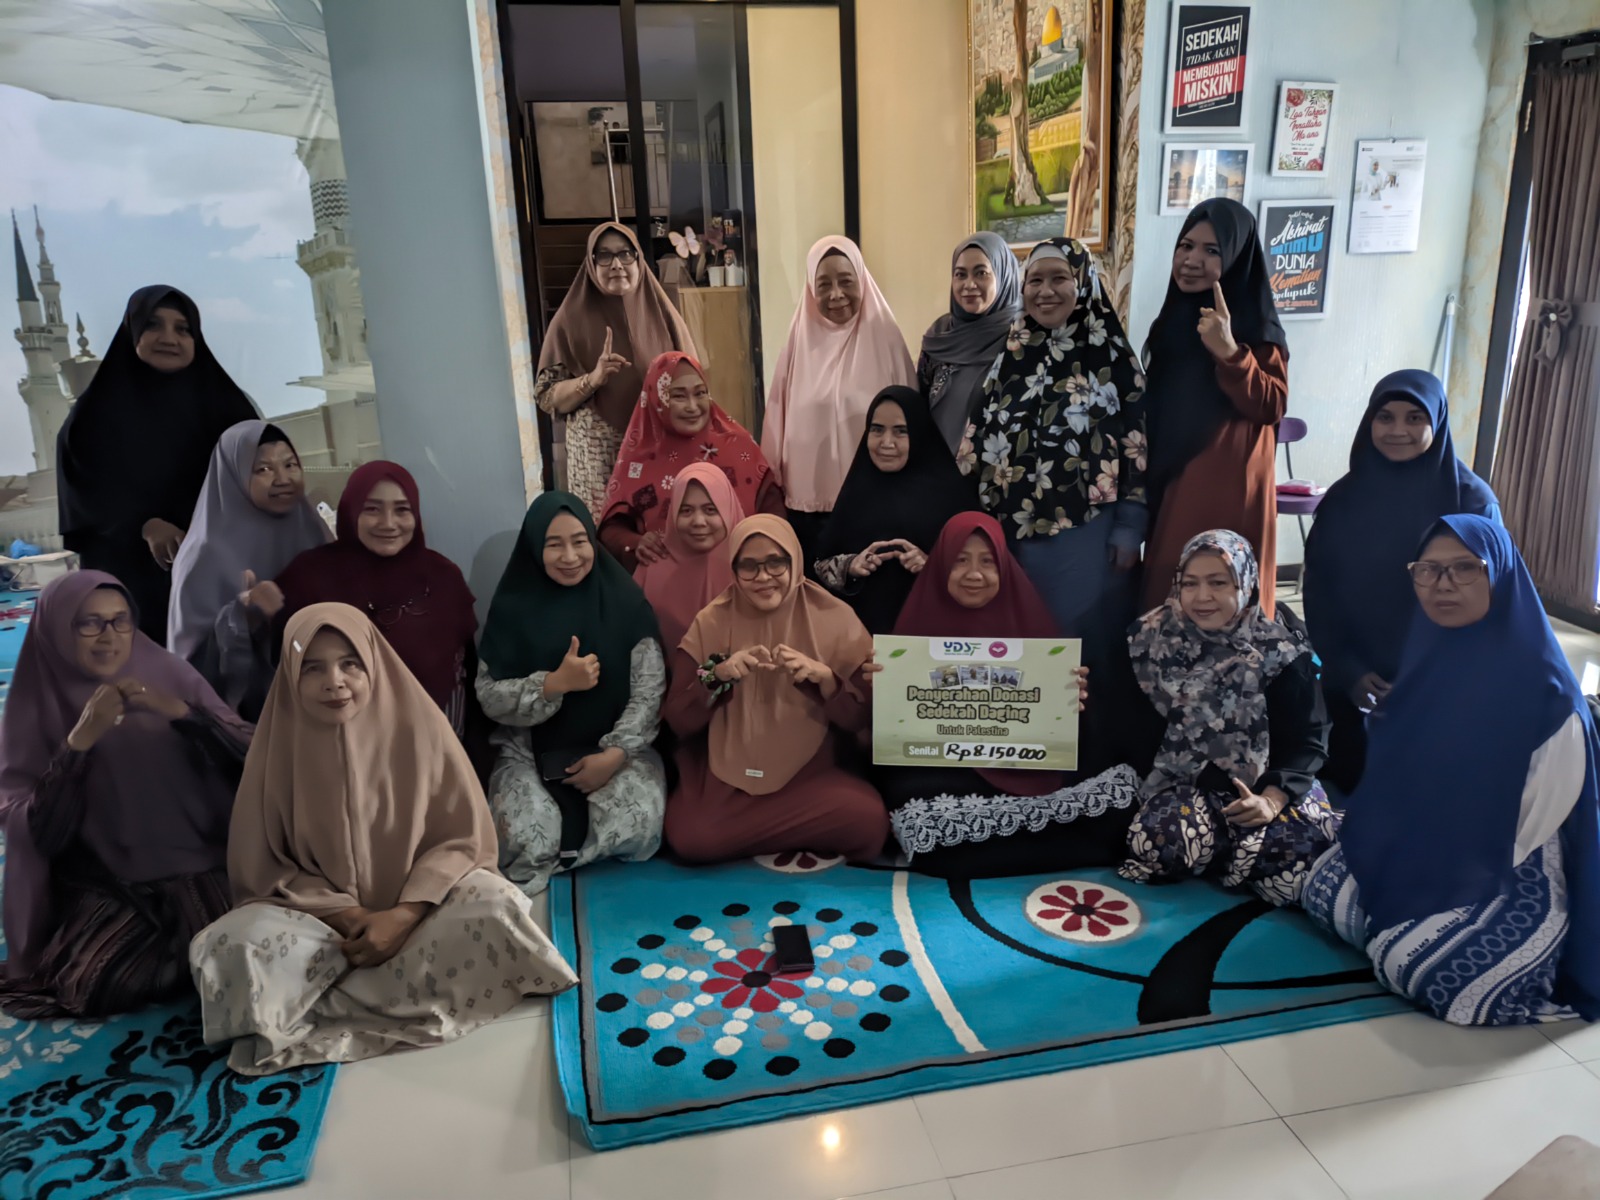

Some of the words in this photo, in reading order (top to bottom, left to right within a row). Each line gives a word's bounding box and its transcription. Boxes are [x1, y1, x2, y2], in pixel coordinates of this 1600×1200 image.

[1185, 23, 1240, 52] SEDEKAH
[1186, 51, 1212, 66] TIDAK
[1212, 45, 1236, 60] AKAN
[1183, 58, 1237, 83] MEMBUATMU
[1184, 73, 1233, 104] MISKIN
[1270, 216, 1328, 246] Akhirat
[1276, 253, 1315, 270] DUNIA
[1269, 268, 1322, 293] Kematian
[943, 641, 981, 656] YDSF
[907, 685, 990, 704] Penyerahan
[991, 687, 1041, 703] Donasi
[917, 703, 977, 719] Sedekah
[978, 704, 1030, 723] Daging
[937, 724, 964, 735] Untuk
[966, 725, 1009, 736] Palestina
[908, 745, 939, 756] Senilai
